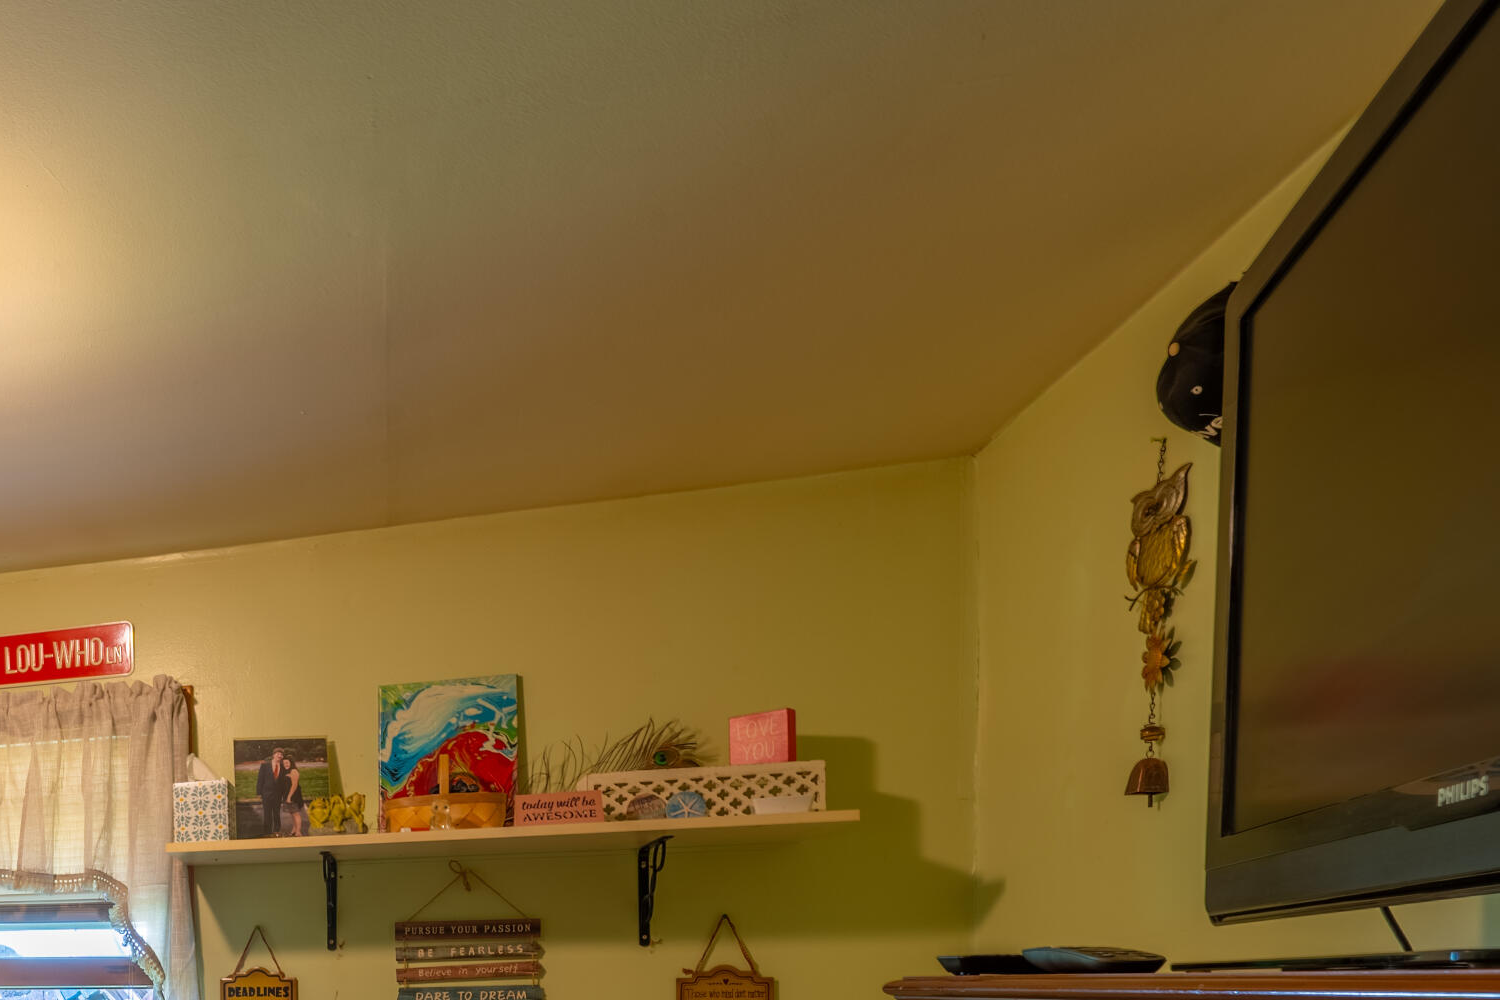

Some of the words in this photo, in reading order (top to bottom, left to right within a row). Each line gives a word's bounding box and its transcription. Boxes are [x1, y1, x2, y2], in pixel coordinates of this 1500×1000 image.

[4, 637, 104, 675] LOU-WHO
[106, 644, 124, 664] LN
[736, 716, 781, 741] LOVE
[741, 741, 775, 761] YOU
[1437, 775, 1489, 807] PHILIPS
[522, 800, 554, 811] today
[556, 797, 581, 808] will
[582, 796, 597, 806] be
[523, 809, 597, 823] AWESOME
[404, 926, 446, 936] PURSUE
[450, 924, 478, 934] YOUR
[484, 922, 532, 933] PASSION
[417, 948, 434, 958] BE
[450, 944, 524, 957] FEARLESS
[418, 968, 452, 977] Believe
[458, 967, 469, 975] in
[227, 986, 290, 998] DEADLINES
[457, 990, 473, 1000] TO
[480, 990, 527, 1000] DREAM
